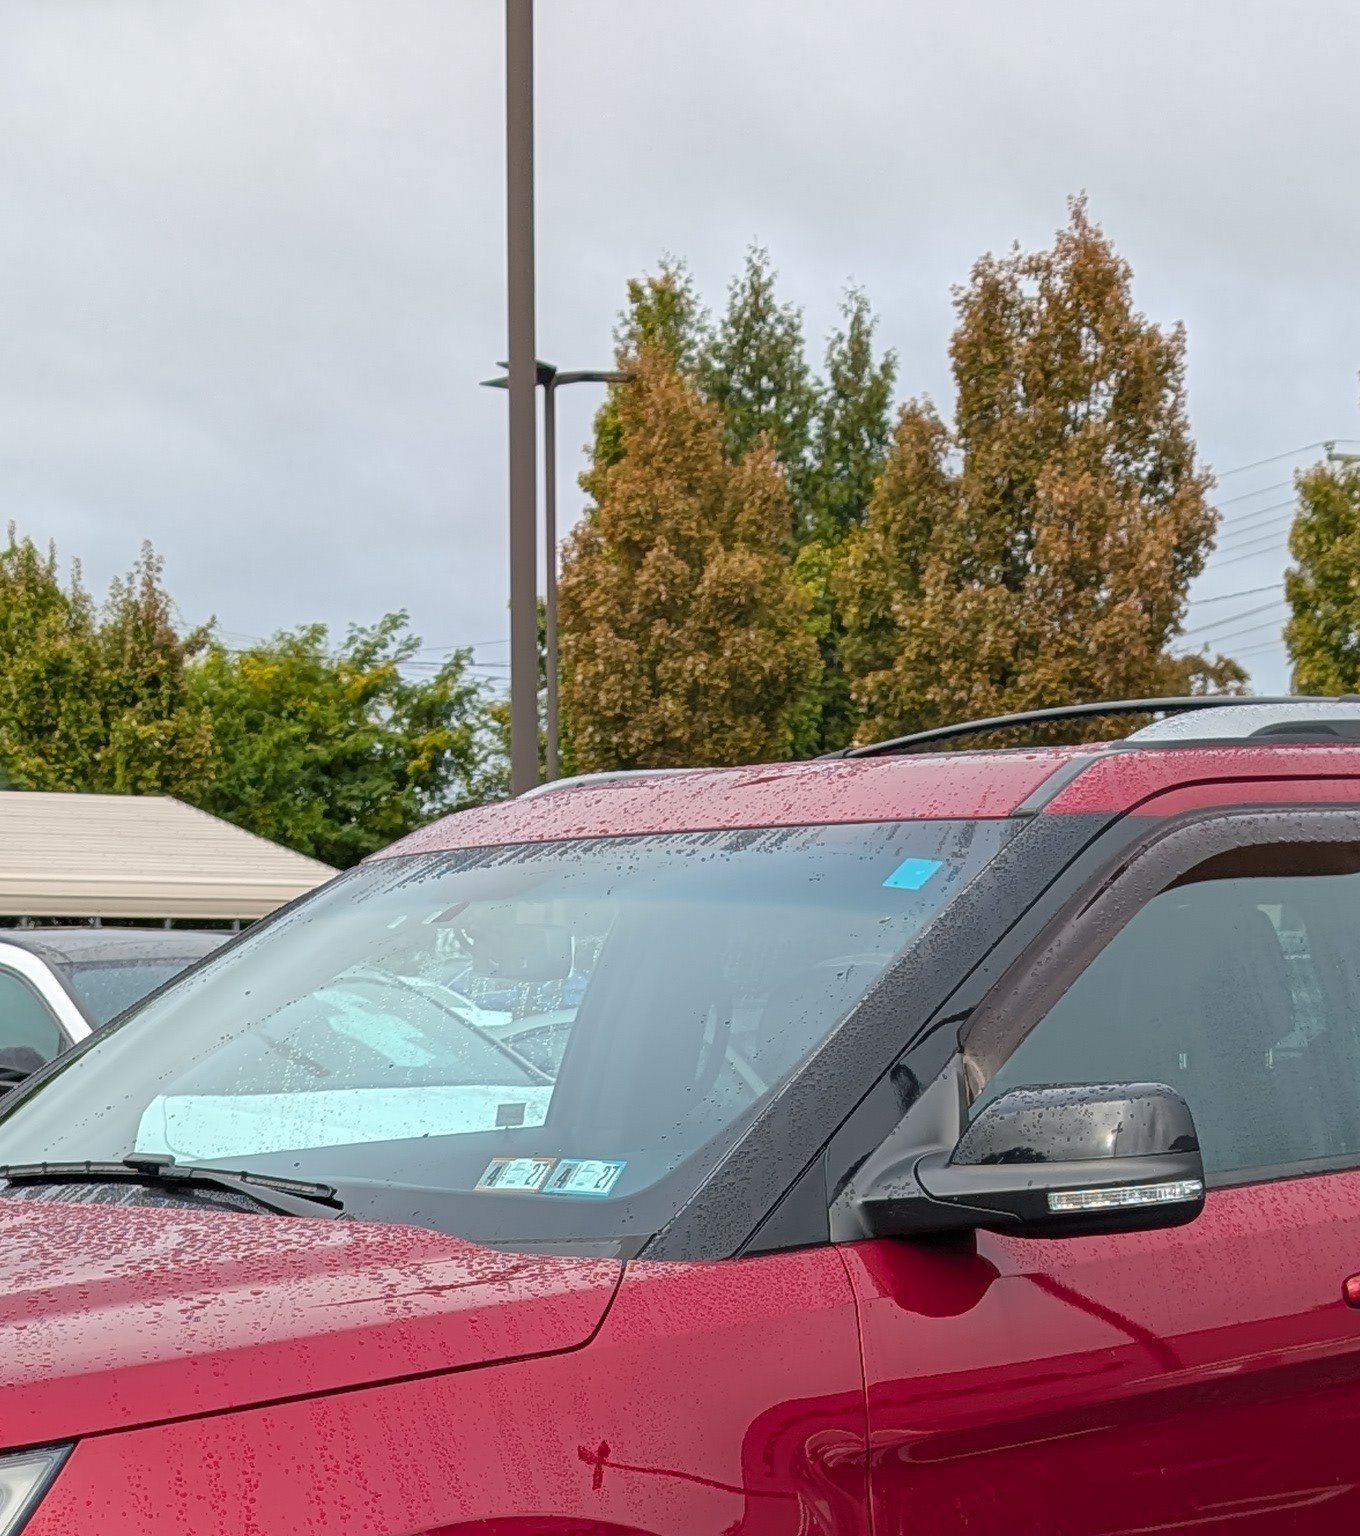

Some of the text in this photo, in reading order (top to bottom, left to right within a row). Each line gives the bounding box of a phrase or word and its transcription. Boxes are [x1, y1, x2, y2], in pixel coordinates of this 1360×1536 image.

[486, 1166, 501, 1187] 4
[524, 1163, 549, 1187] 27
[553, 1168, 572, 1189] 4
[593, 1165, 620, 1190] 27
